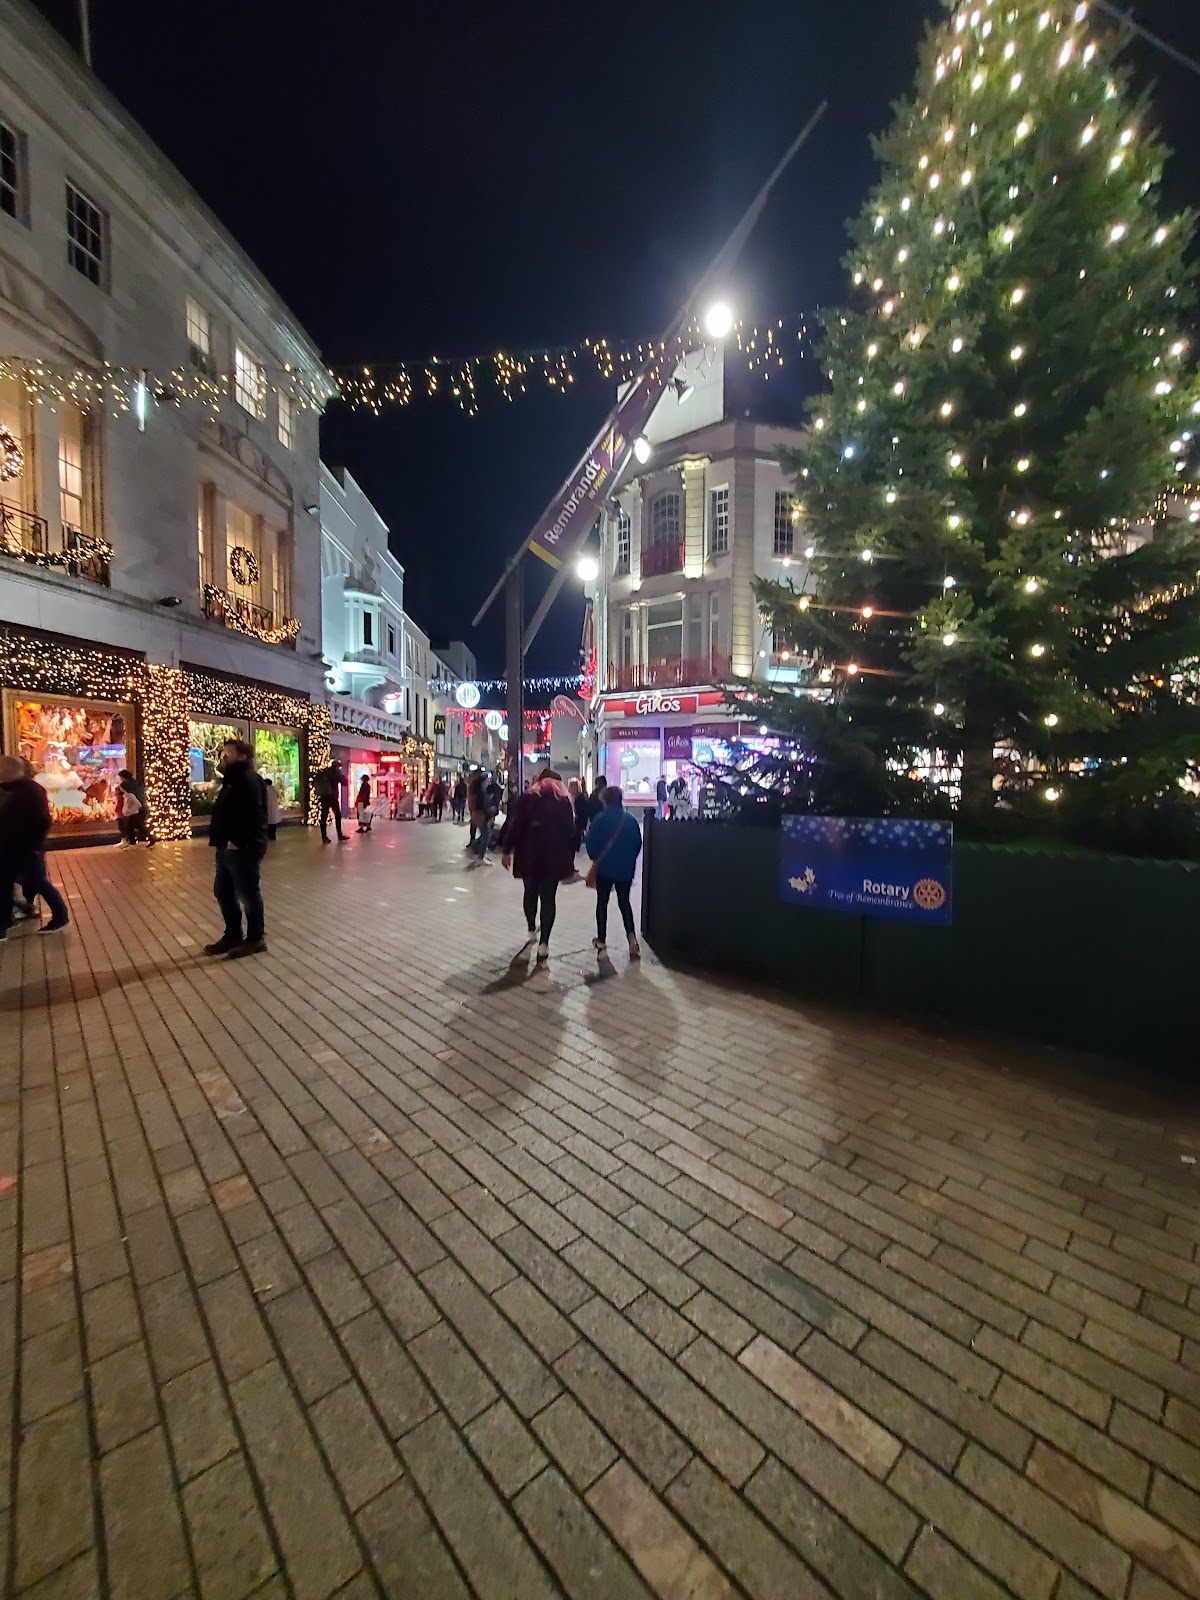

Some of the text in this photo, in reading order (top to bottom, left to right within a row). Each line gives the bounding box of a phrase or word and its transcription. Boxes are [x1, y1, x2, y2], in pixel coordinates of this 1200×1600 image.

[593, 467, 608, 493] PRINT
[543, 458, 601, 545] Rembrandt
[636, 690, 681, 716] Gino's
[828, 889, 914, 909] Tree of Remembrance
[863, 879, 909, 900] Rotary
